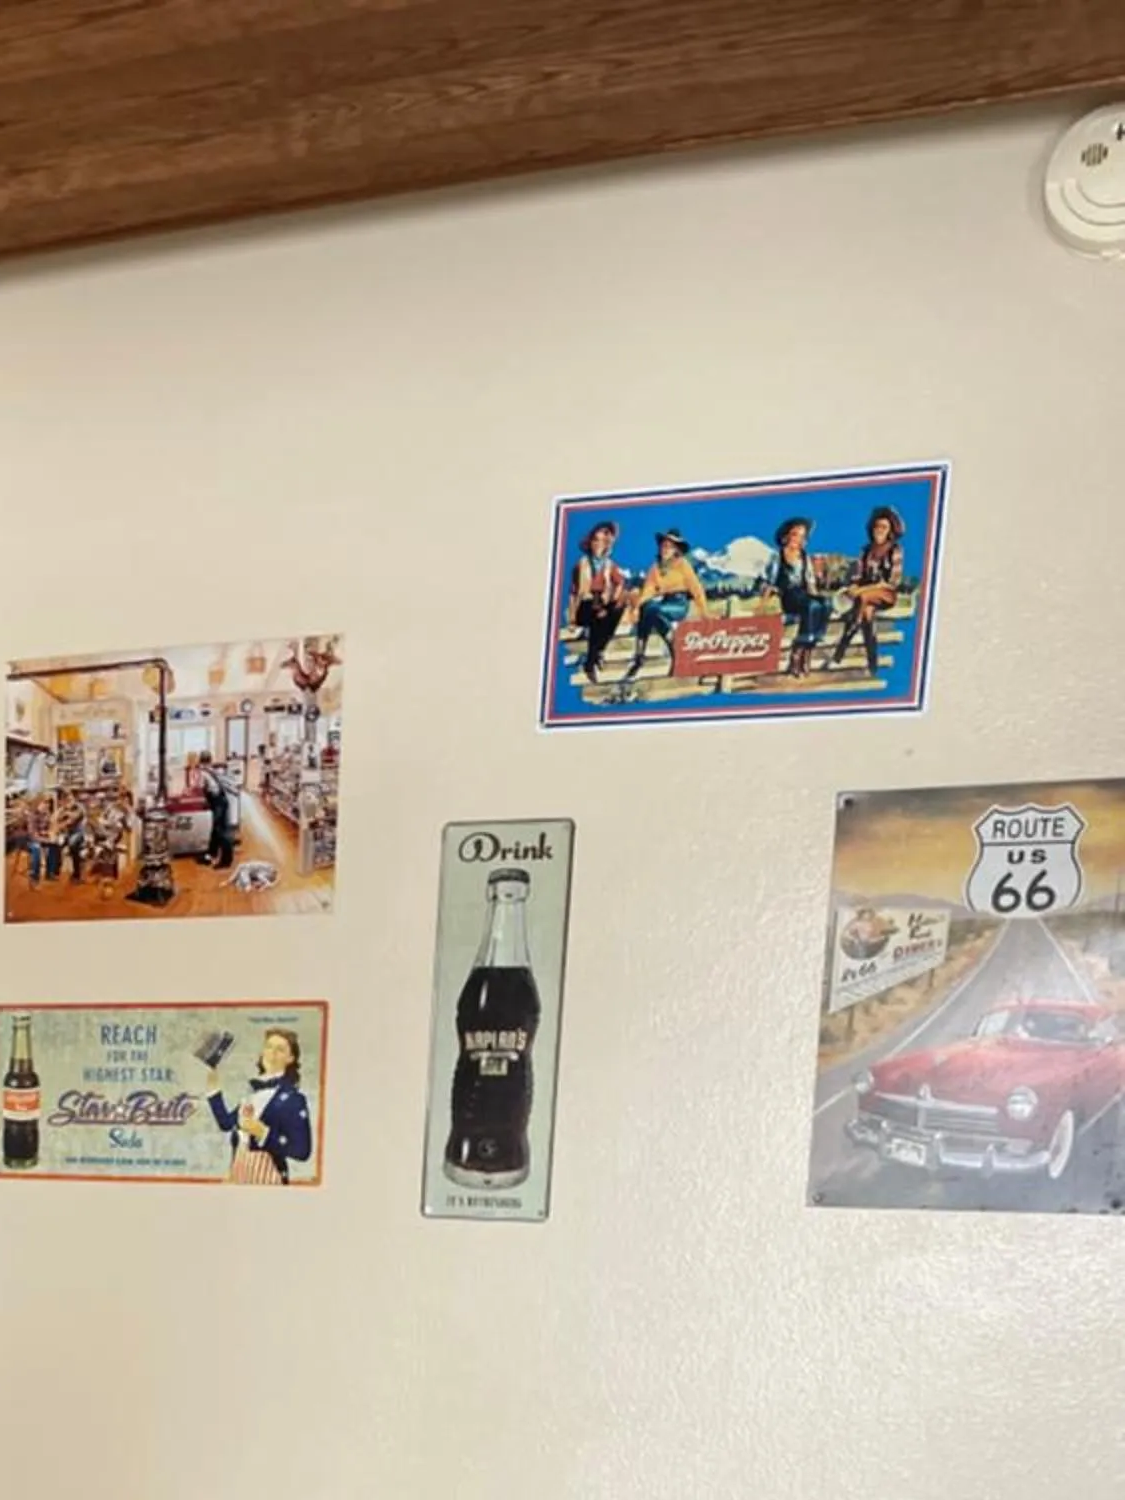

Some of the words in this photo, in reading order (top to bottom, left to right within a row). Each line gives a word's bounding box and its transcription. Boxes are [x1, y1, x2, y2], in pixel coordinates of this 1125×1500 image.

[992, 816, 1065, 839] ROUTE
[458, 830, 554, 863] Drink
[991, 869, 1055, 912] 66
[100, 1023, 157, 1046] REACH
[82, 1066, 136, 1083] HIGHEST
